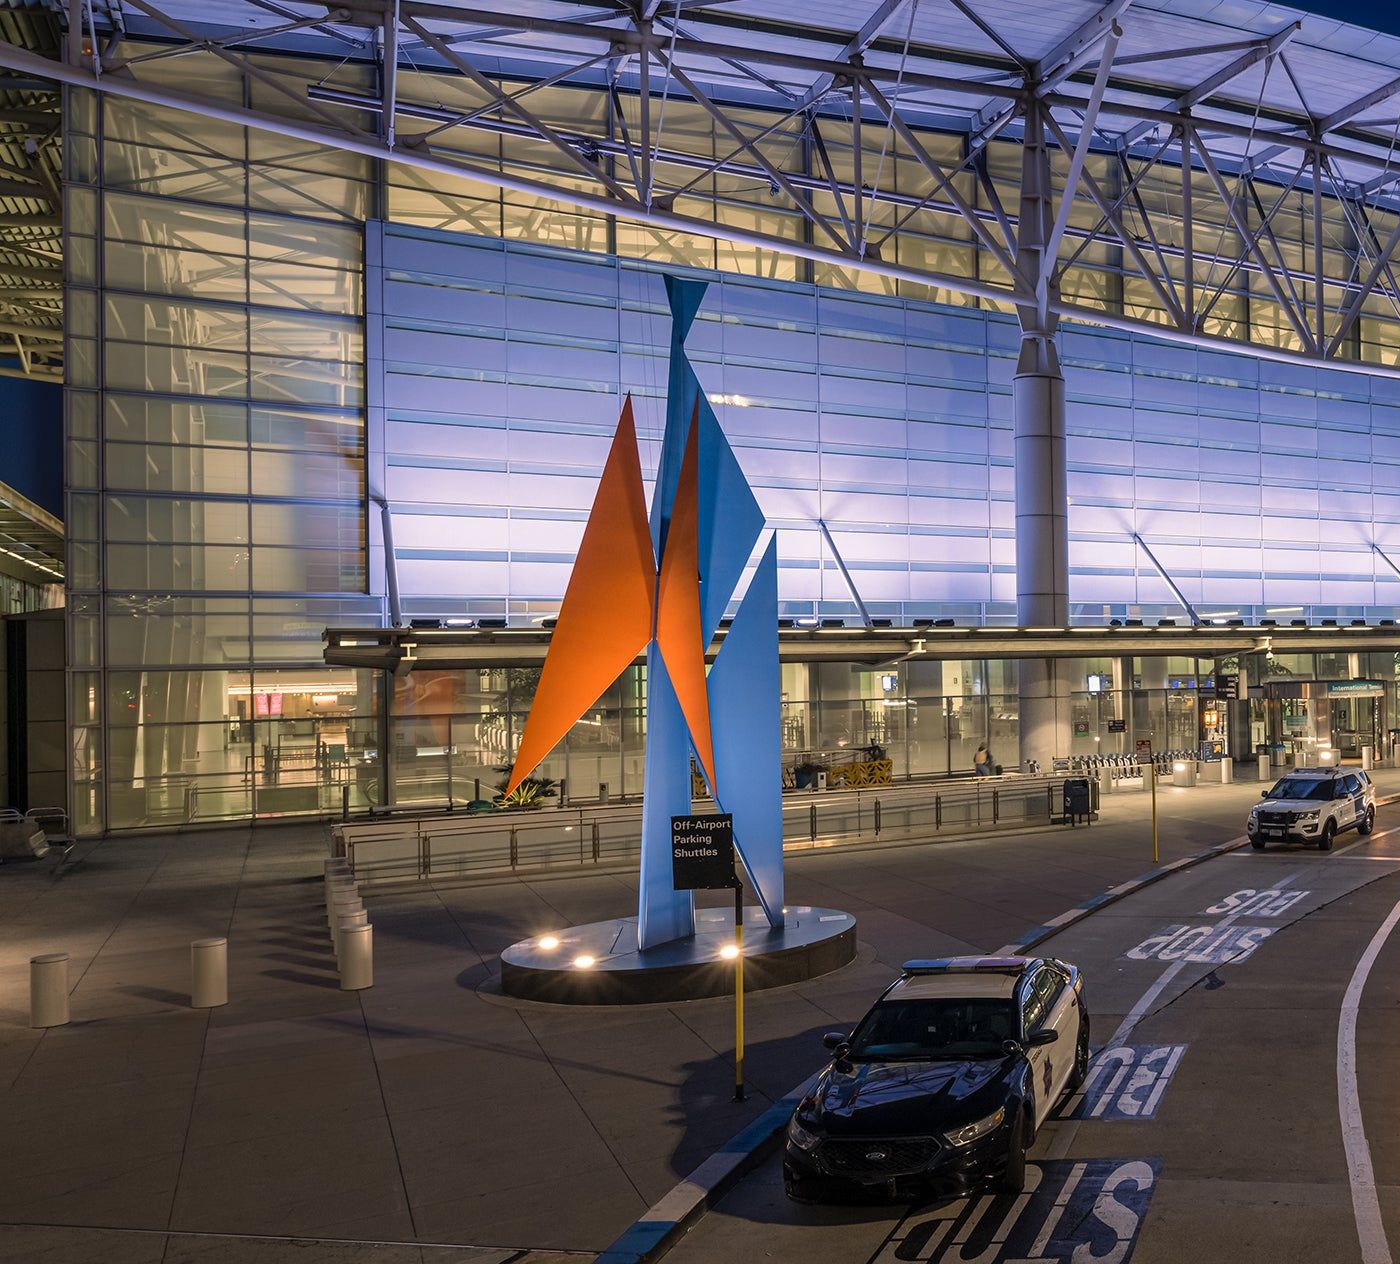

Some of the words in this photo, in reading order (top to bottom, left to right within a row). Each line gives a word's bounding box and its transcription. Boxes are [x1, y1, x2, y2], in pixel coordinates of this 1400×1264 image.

[673, 820, 731, 831] Off-Airport
[673, 834, 712, 845] Parking
[674, 848, 718, 858] Shuttles
[1206, 889, 1311, 916] BUS
[1126, 925, 1272, 963] STOP
[1058, 1046, 1185, 1118] BU
